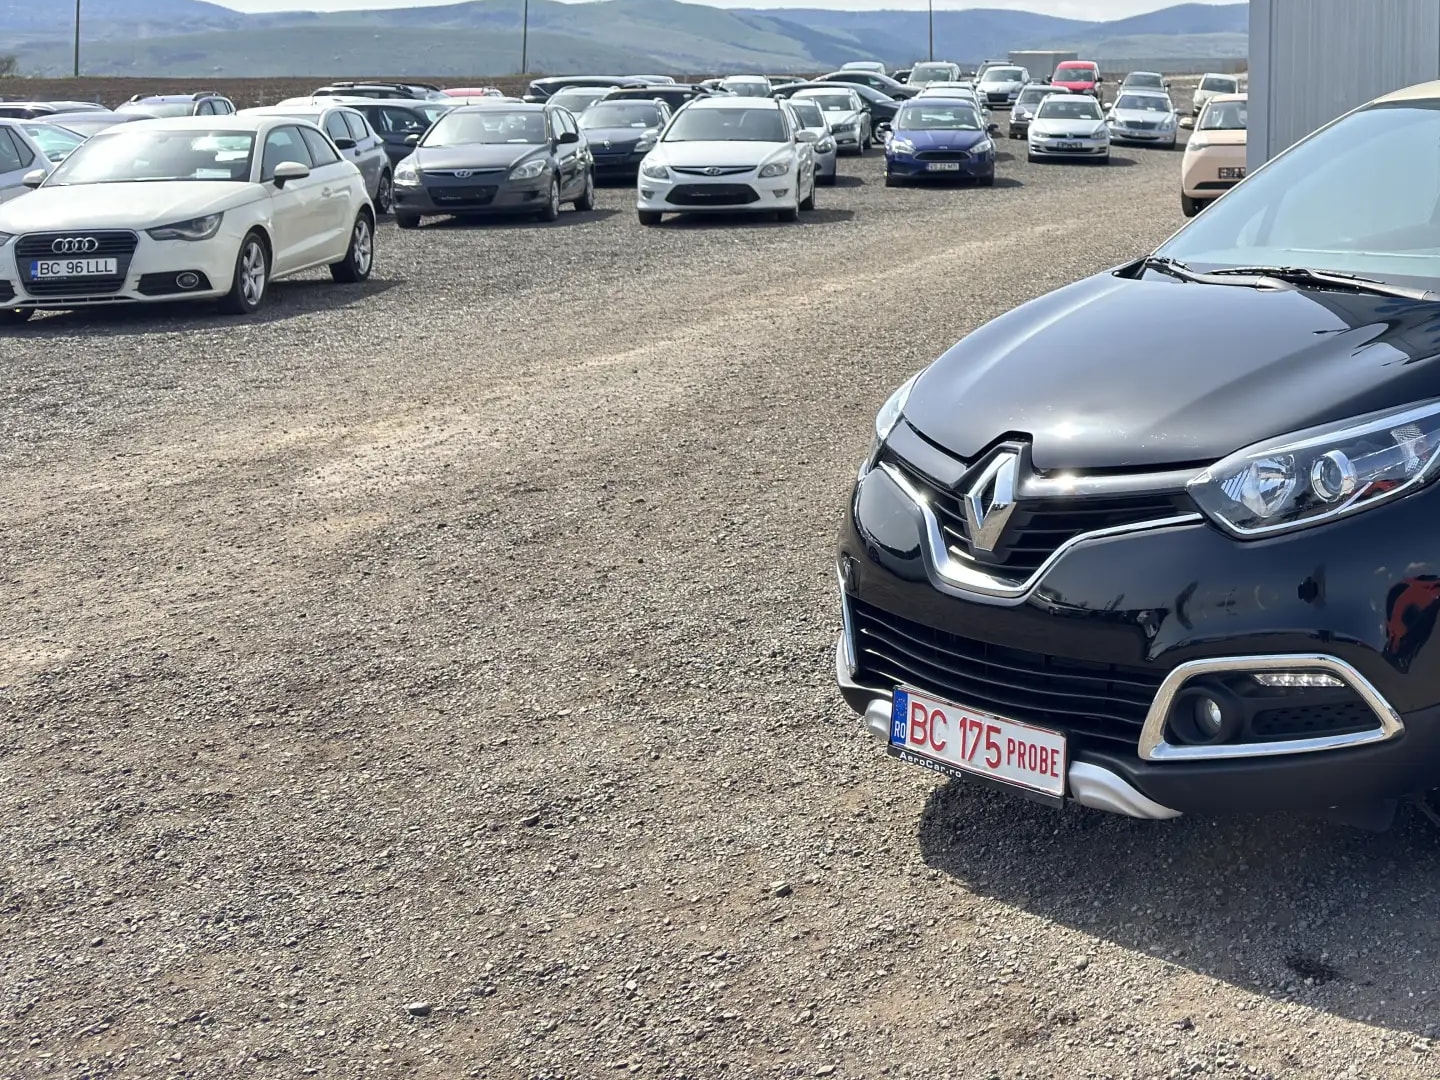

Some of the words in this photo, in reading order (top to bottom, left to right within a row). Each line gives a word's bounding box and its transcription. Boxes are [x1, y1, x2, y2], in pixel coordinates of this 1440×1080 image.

[40, 262, 60, 275] BC
[66, 261, 83, 274] 96
[86, 260, 113, 273] LLL
[893, 720, 906, 740] RO
[909, 701, 947, 752] BC
[959, 716, 1002, 769] 175
[1006, 737, 1060, 778] PROBE
[899, 751, 962, 778] AeroCar.ro
